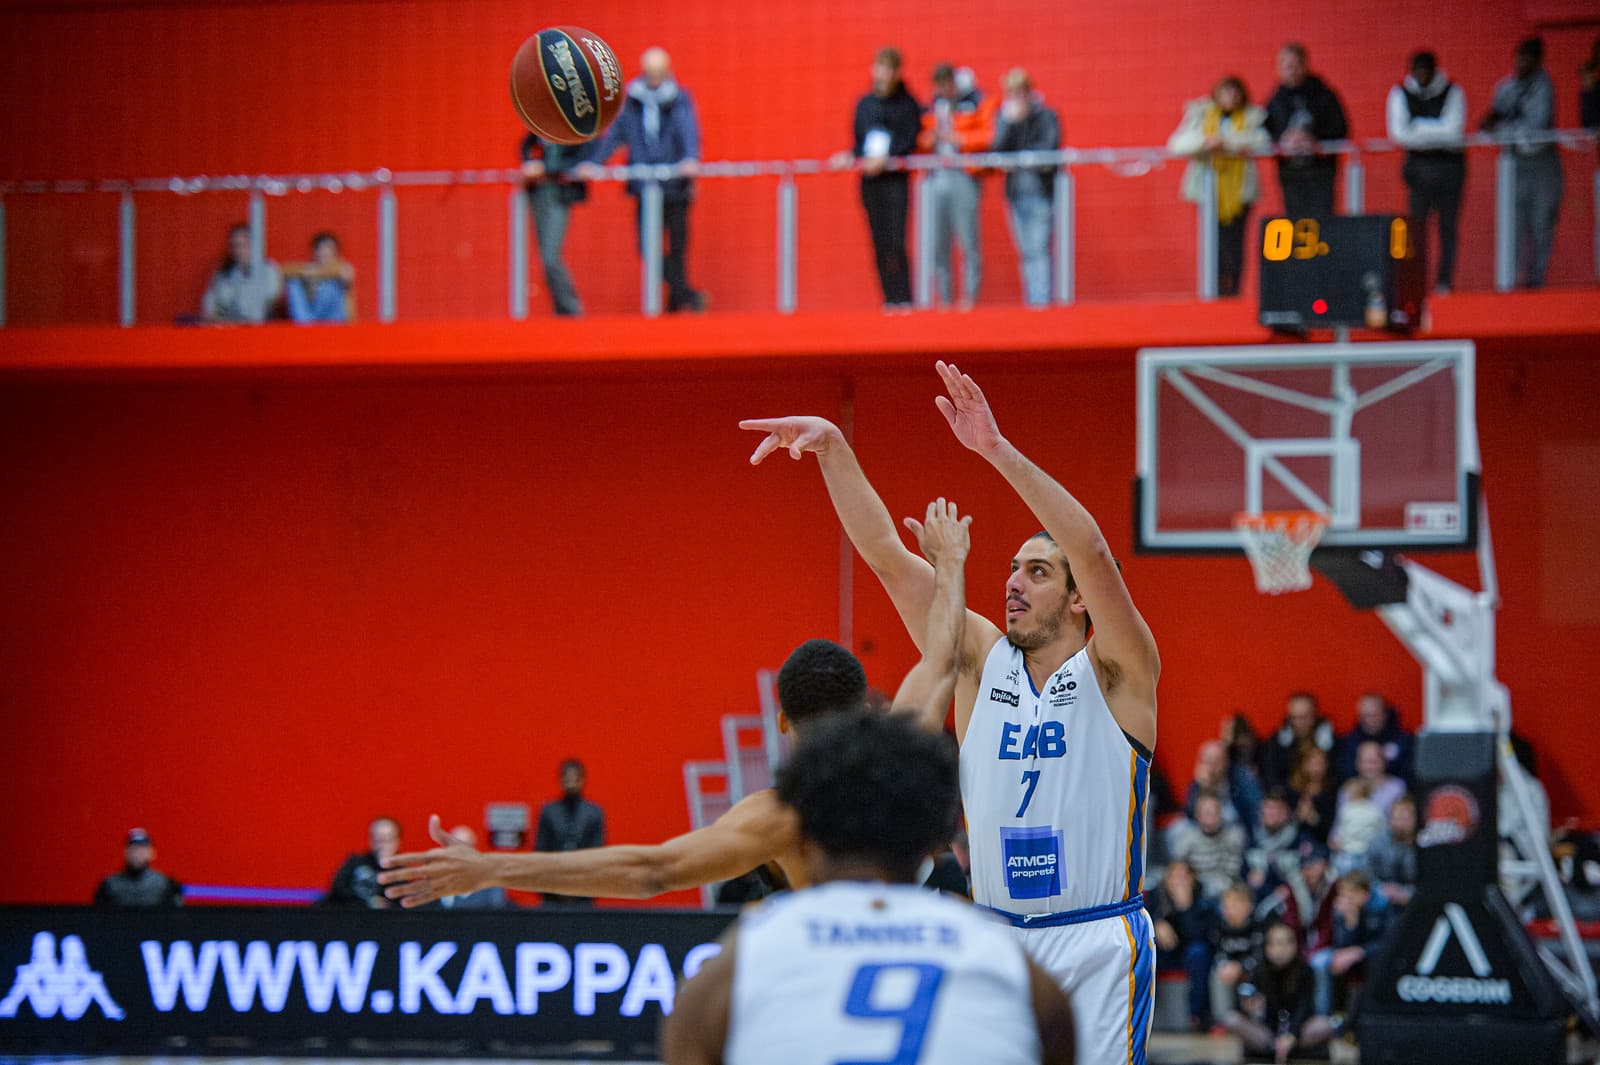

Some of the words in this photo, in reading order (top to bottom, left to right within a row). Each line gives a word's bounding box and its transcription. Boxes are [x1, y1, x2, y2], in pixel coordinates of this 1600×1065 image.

[998, 720, 1067, 761] EAB
[1015, 769, 1041, 818] 7
[1007, 853, 1057, 868] ATMOS
[1012, 865, 1056, 879] propreté
[829, 962, 945, 1065] 9
